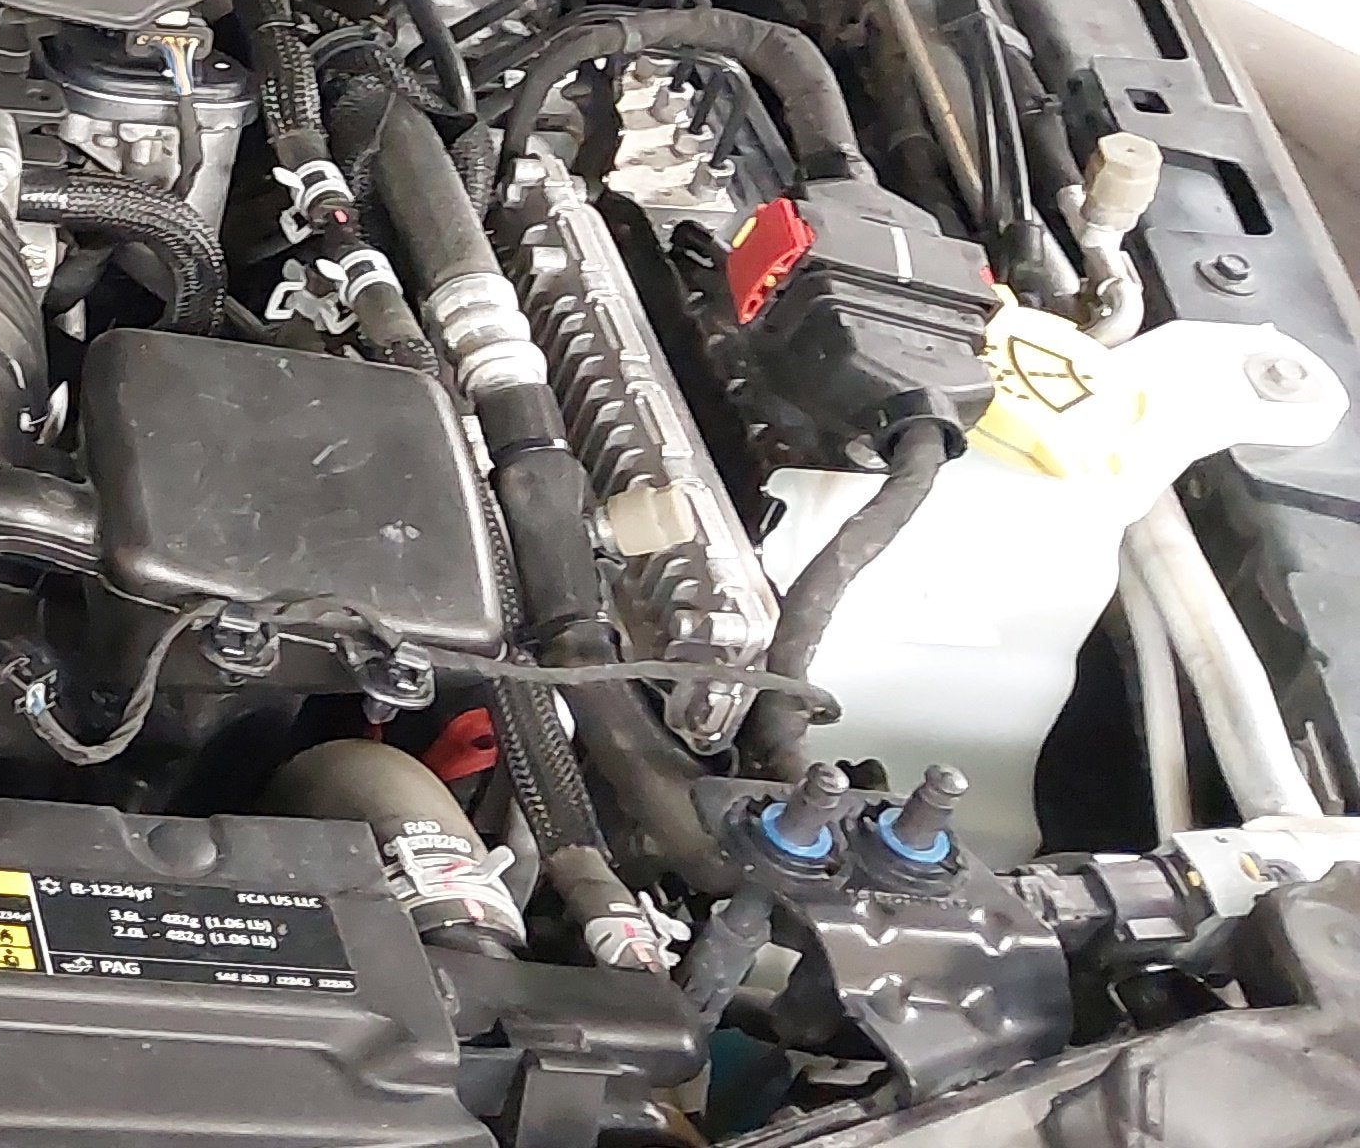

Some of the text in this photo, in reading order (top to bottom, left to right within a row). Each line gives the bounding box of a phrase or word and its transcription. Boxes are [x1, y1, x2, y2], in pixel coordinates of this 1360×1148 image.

[69, 882, 153, 902] R-1234yf
[236, 893, 323, 908] FCA US LLC
[108, 908, 145, 923] 3.6L
[112, 925, 148, 939] 2.0L
[99, 960, 142, 976] PAG
